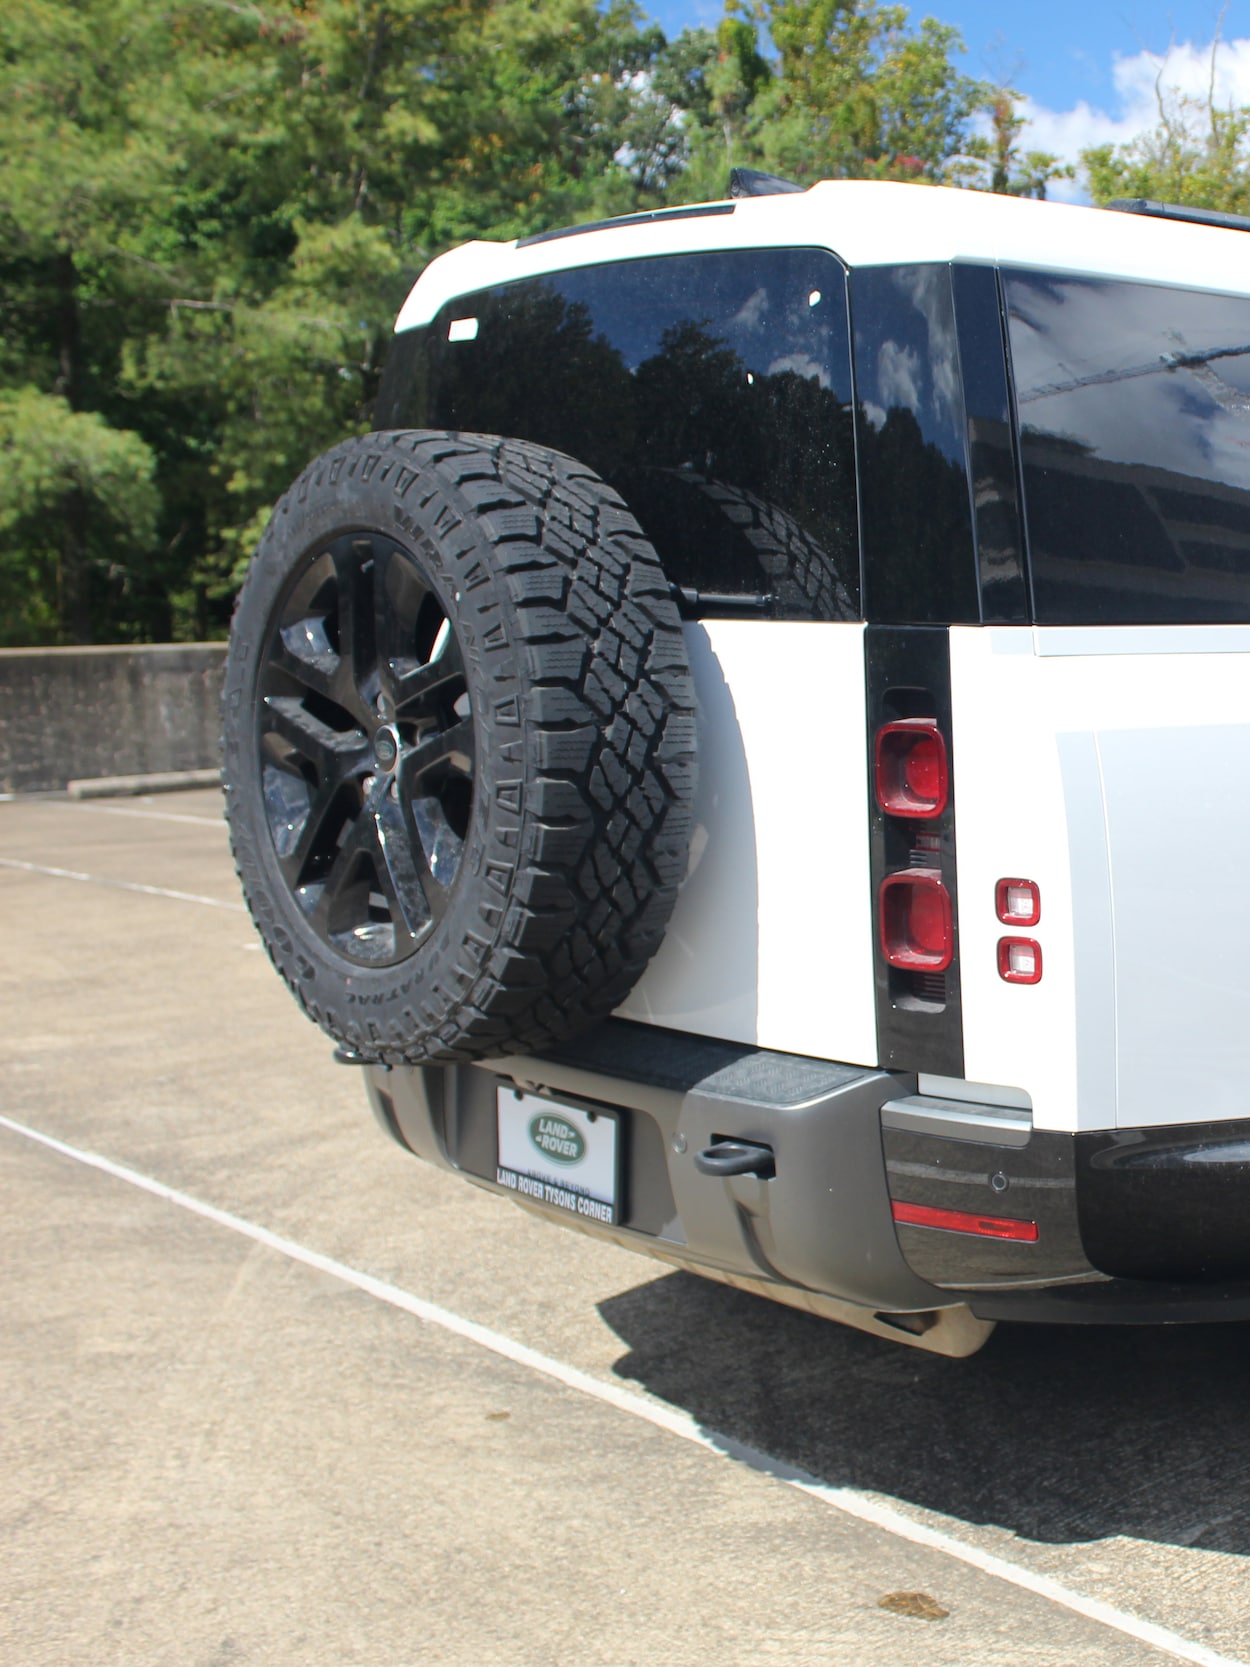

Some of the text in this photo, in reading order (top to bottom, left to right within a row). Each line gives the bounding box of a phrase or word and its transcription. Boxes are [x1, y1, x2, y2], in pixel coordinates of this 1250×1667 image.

[538, 1118, 569, 1139] LAND
[541, 1134, 578, 1157] ROVER
[497, 1167, 613, 1224] LAND ROVER TYSONS CORNER
